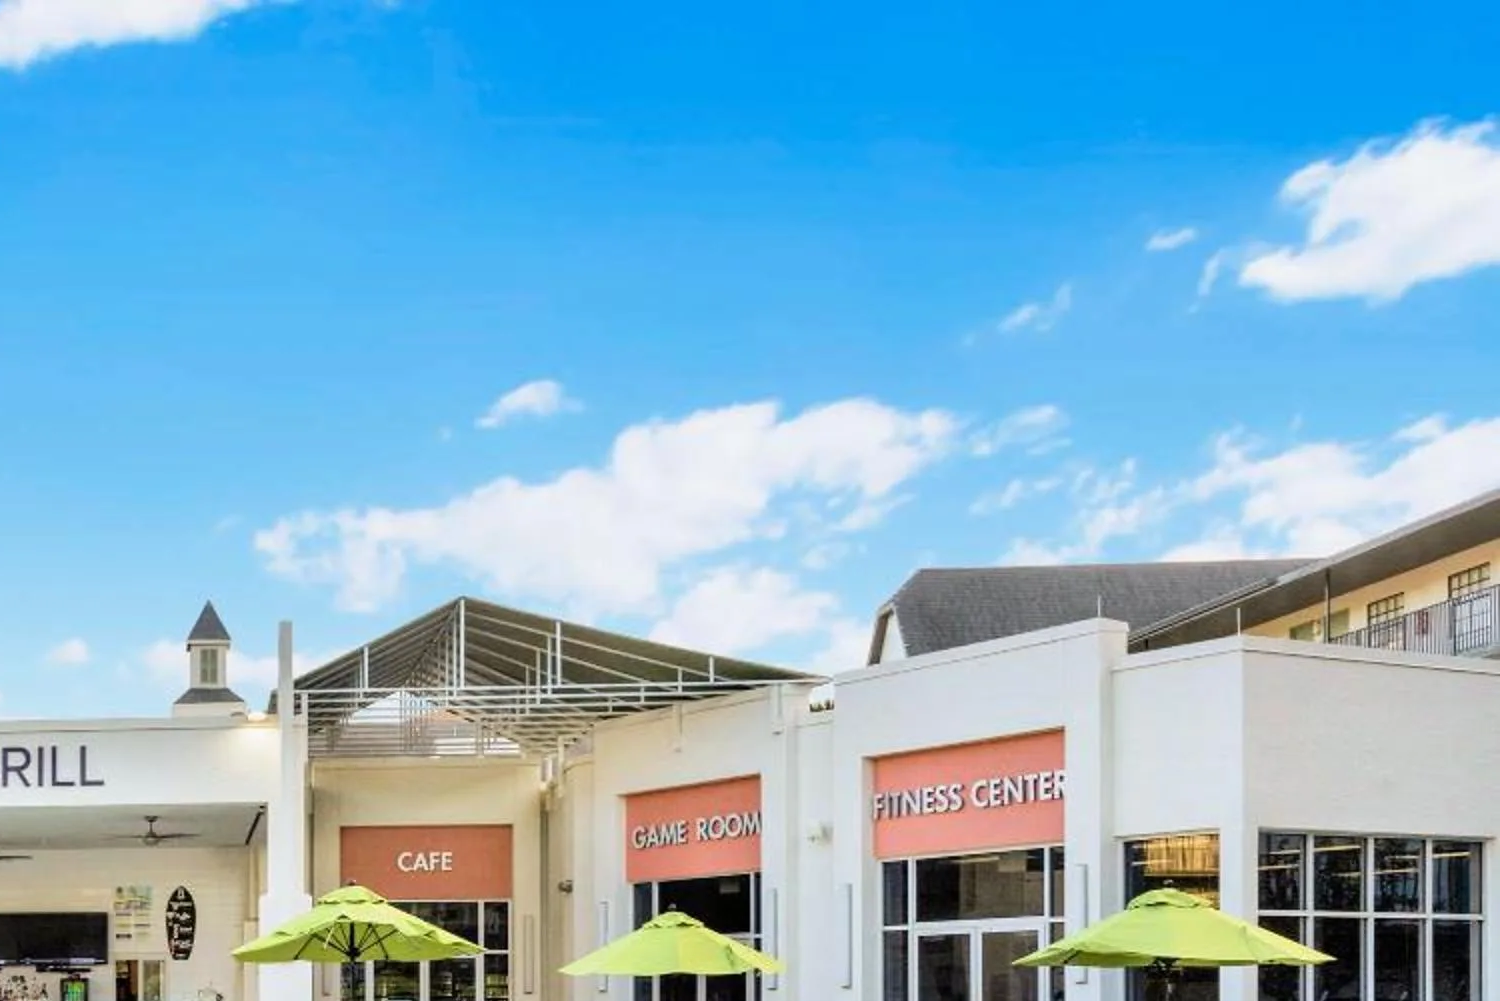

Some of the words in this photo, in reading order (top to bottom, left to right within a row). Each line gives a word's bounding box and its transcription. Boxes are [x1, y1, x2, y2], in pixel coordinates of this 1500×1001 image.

[873, 784, 964, 820] FITNESS
[970, 769, 1067, 809] CENTER
[632, 819, 688, 849] GAME
[696, 811, 763, 841] ROOM
[397, 851, 453, 872] CAFE
